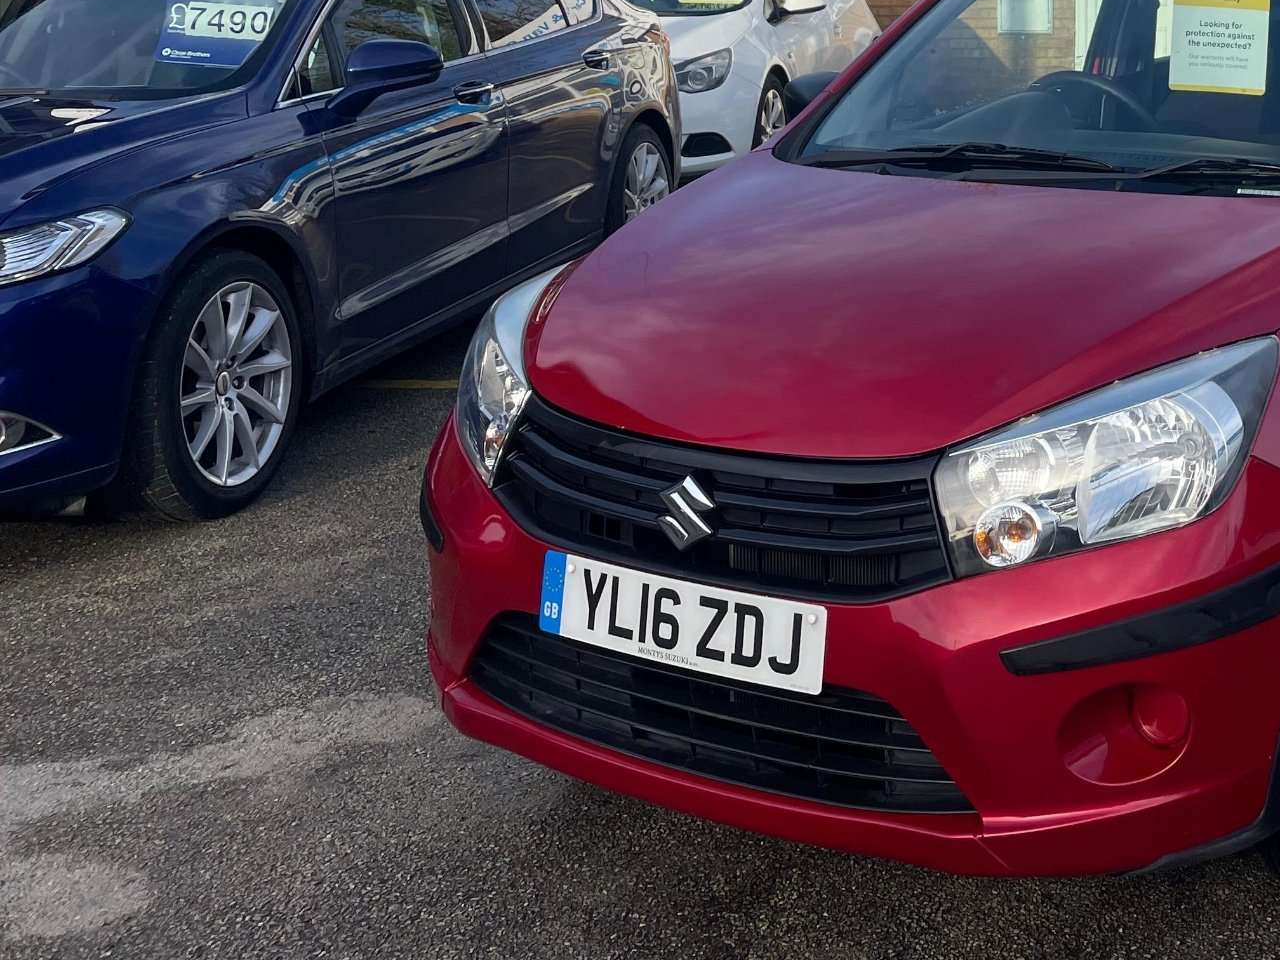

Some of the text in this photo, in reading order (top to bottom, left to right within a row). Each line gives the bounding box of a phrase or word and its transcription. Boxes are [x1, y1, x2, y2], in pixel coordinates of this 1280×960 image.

[169, 2, 269, 34] £7490
[1199, 21, 1243, 29] Looking for
[1185, 30, 1255, 40] protection against
[1188, 39, 1252, 50] the unexpected?
[544, 601, 559, 619] GB
[583, 568, 804, 675] YL16 ZDJ
[637, 645, 665, 659] MONTYS
[664, 651, 689, 665] SUZUKI
